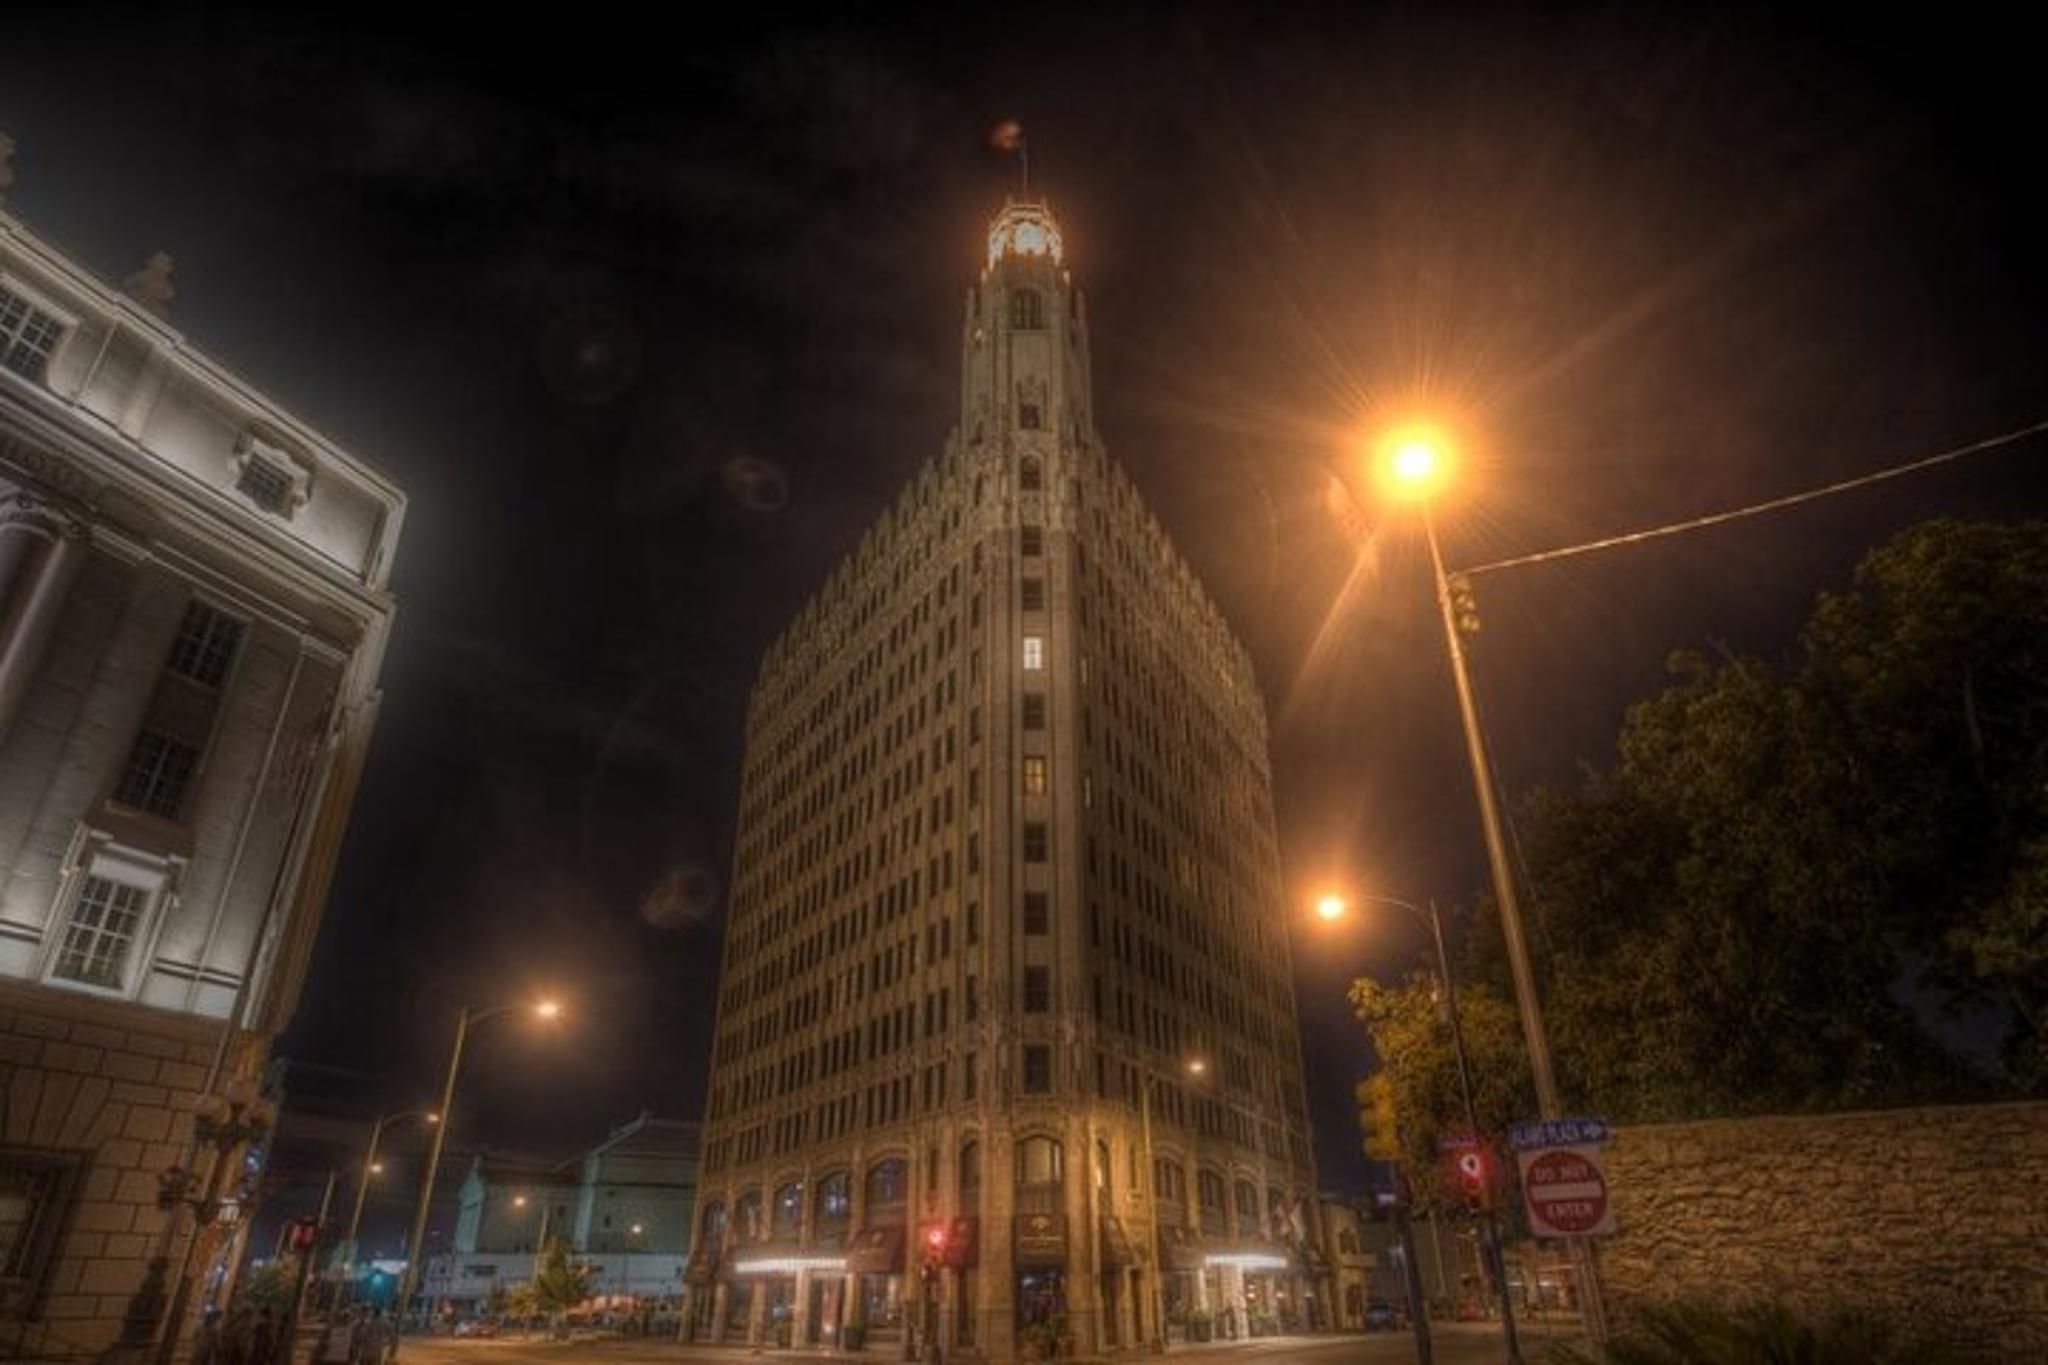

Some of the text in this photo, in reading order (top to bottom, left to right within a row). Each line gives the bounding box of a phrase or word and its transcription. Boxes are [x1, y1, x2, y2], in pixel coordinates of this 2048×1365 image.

[1533, 1165, 1588, 1182] DO NOT
[1546, 1202, 1595, 1218] ENTER
